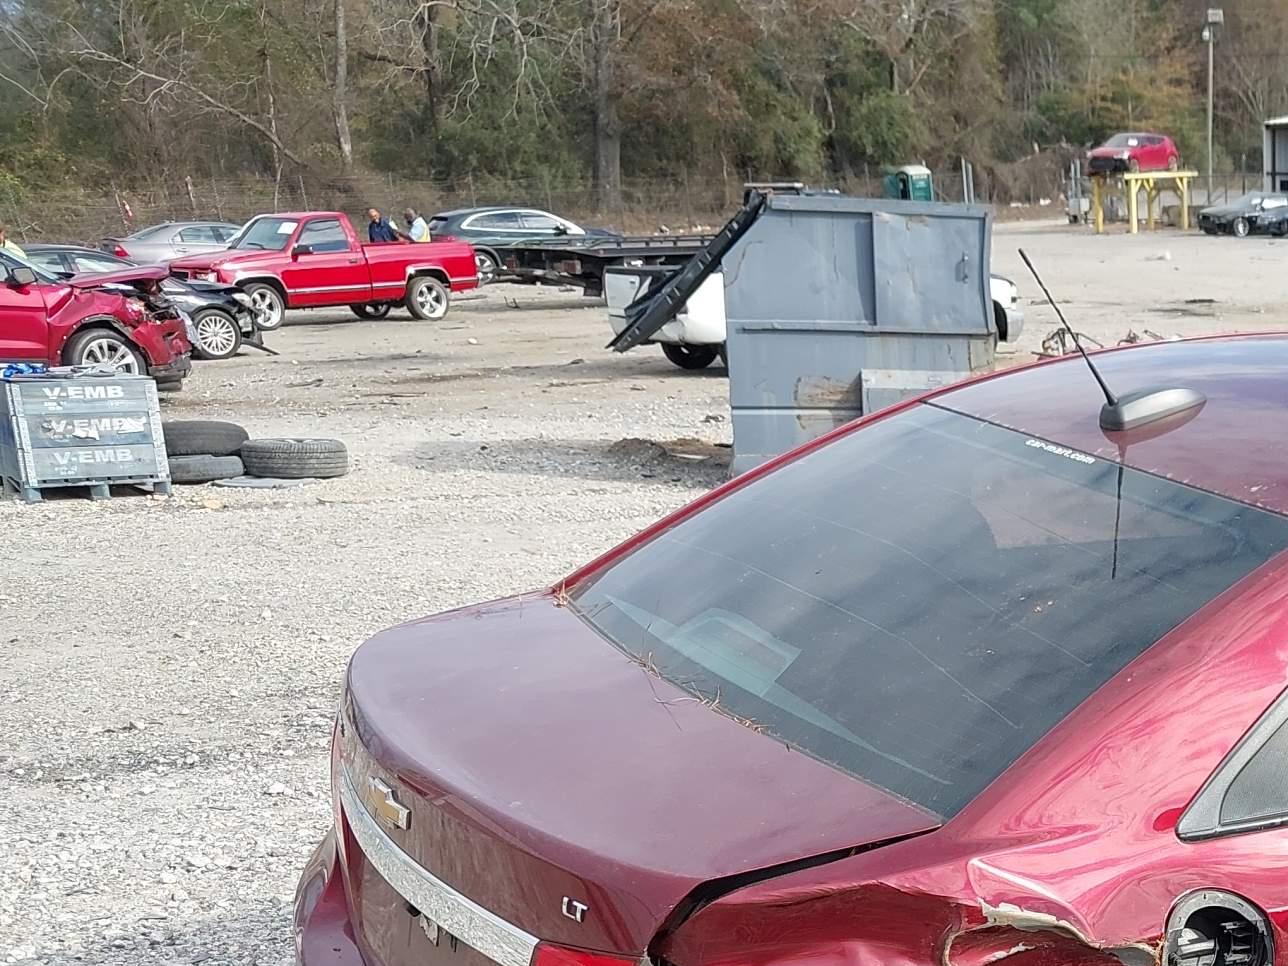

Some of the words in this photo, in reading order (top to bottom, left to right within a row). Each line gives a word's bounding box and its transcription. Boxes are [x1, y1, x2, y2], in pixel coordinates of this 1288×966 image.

[42, 385, 124, 400] V-EMB
[53, 448, 134, 465] V-EMB
[1025, 439, 1097, 465] car-mart.com
[561, 896, 590, 923] LT
